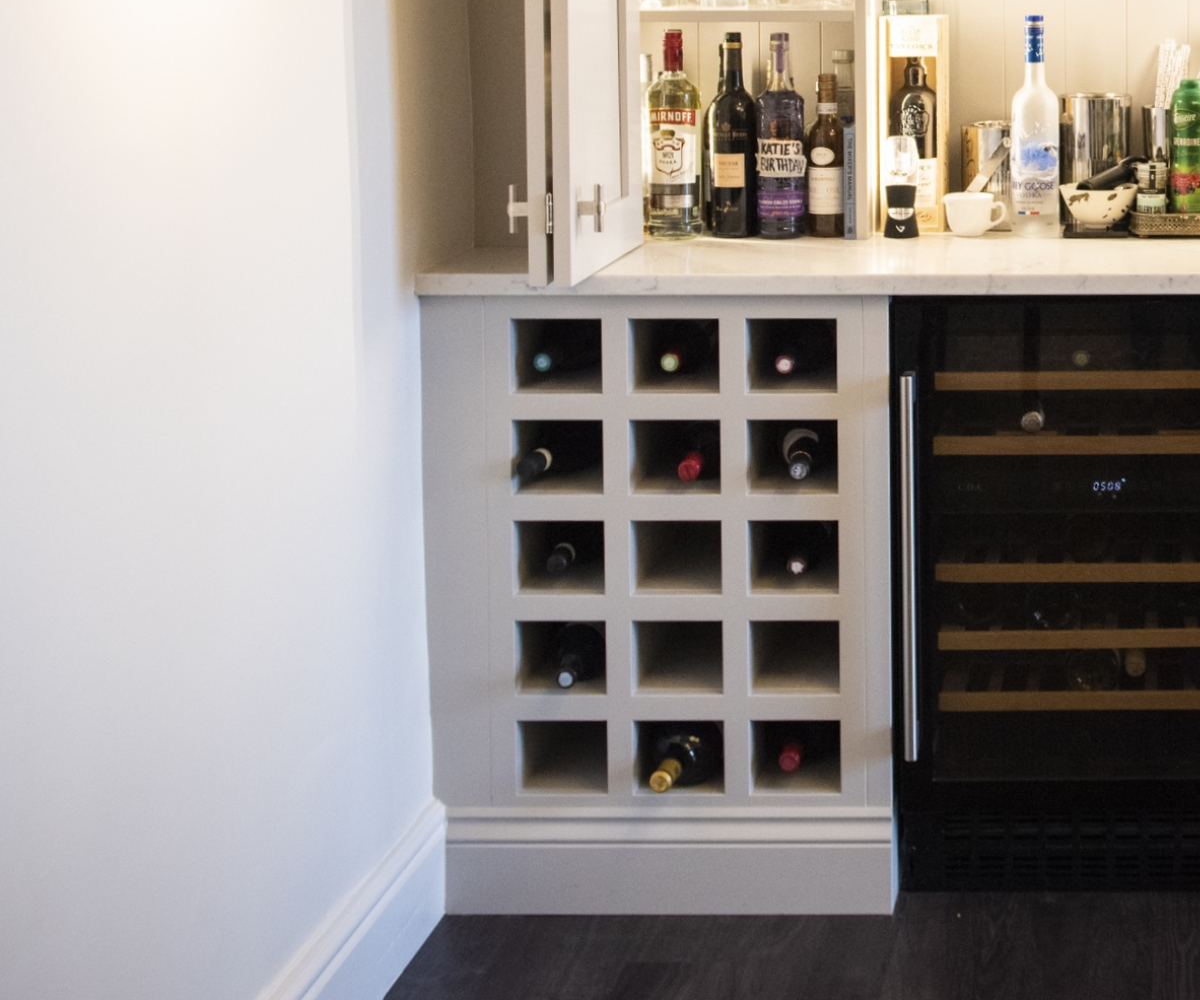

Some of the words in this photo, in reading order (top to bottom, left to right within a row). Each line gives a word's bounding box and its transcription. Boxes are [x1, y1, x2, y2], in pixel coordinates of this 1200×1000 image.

[760, 142, 801, 156] KATIE'S
[760, 157, 804, 174] BIRTHDAY
[1024, 182, 1054, 191] GOOSE
[958, 483, 982, 492] CDA
